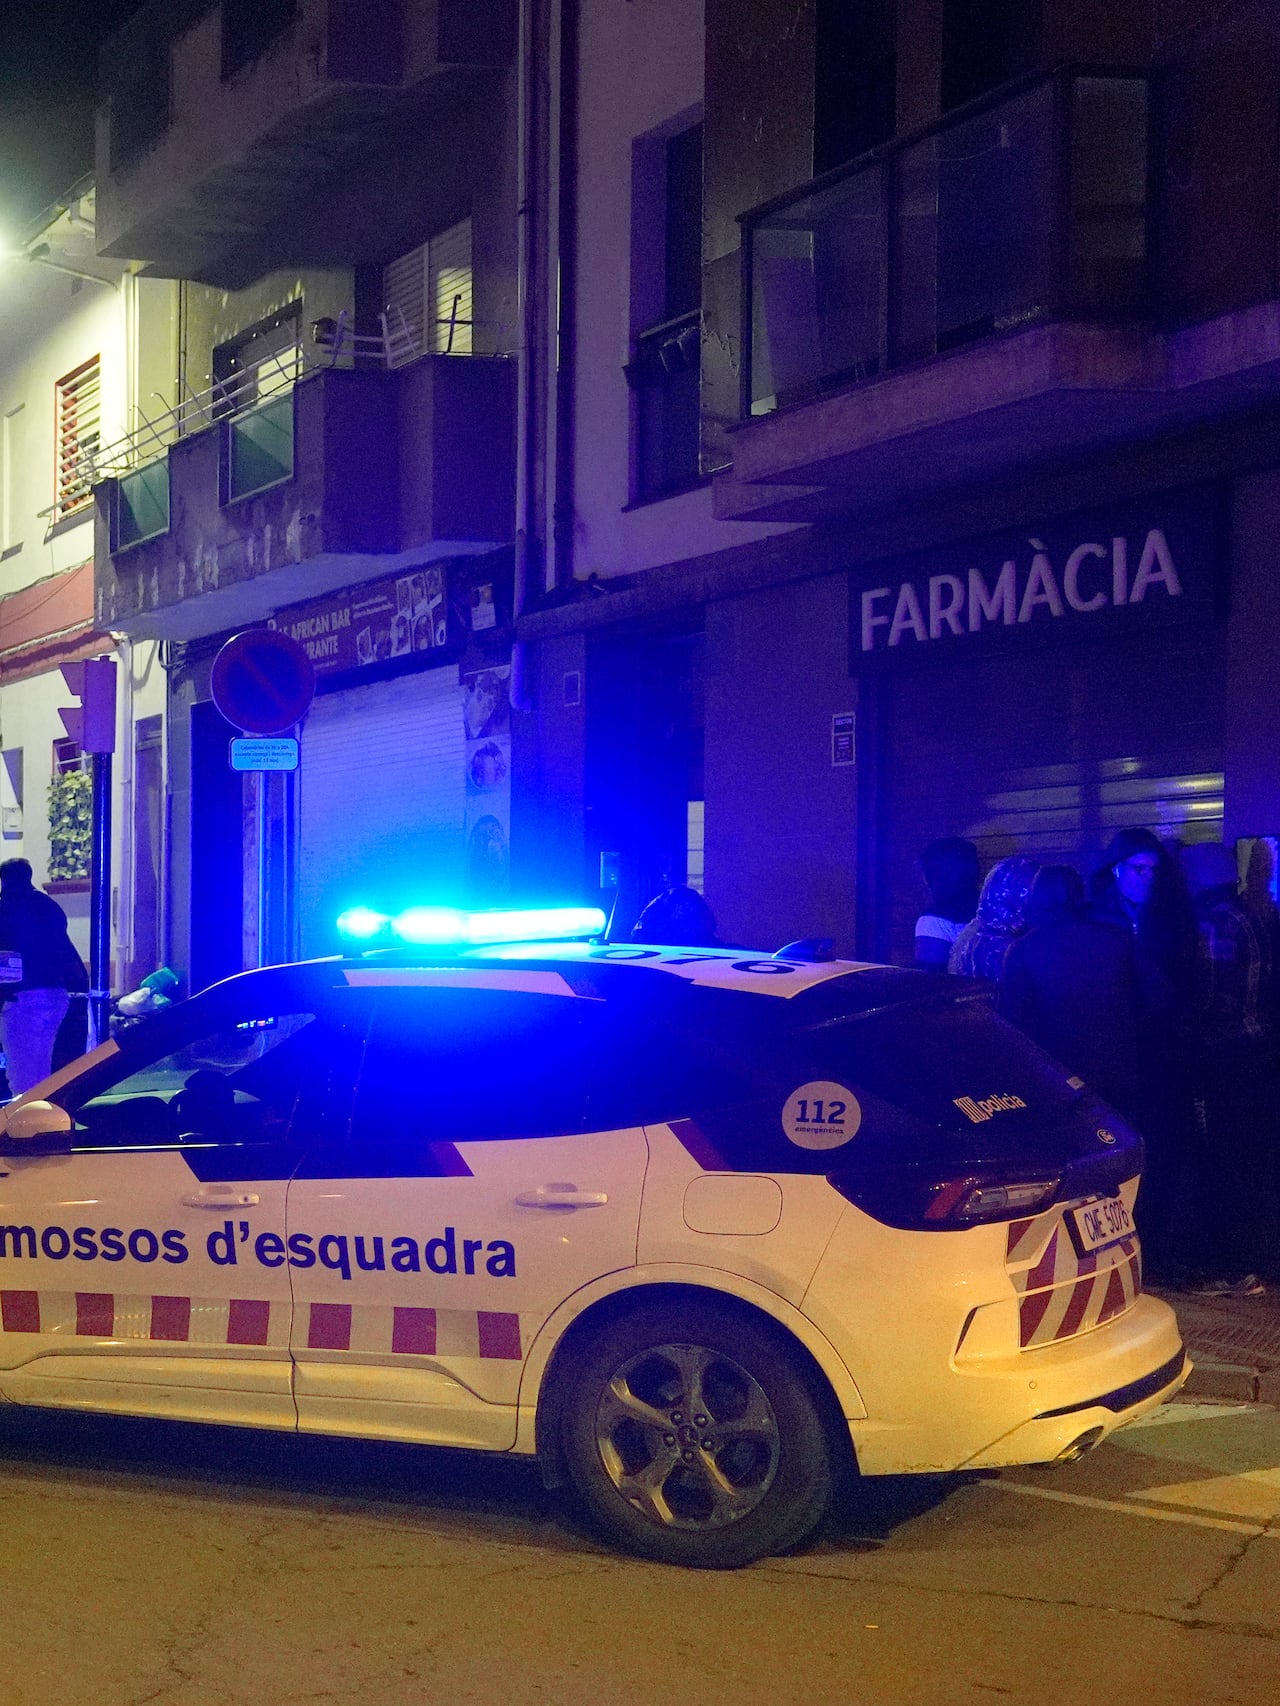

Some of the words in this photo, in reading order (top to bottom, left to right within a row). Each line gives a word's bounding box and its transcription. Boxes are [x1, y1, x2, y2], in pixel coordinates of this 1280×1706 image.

[861, 529, 1182, 651] FARMÀCIA
[291, 613, 330, 641] AFRICAN
[331, 608, 351, 630] BAR
[795, 1099, 847, 1125] 112
[978, 1093, 1028, 1118] policia
